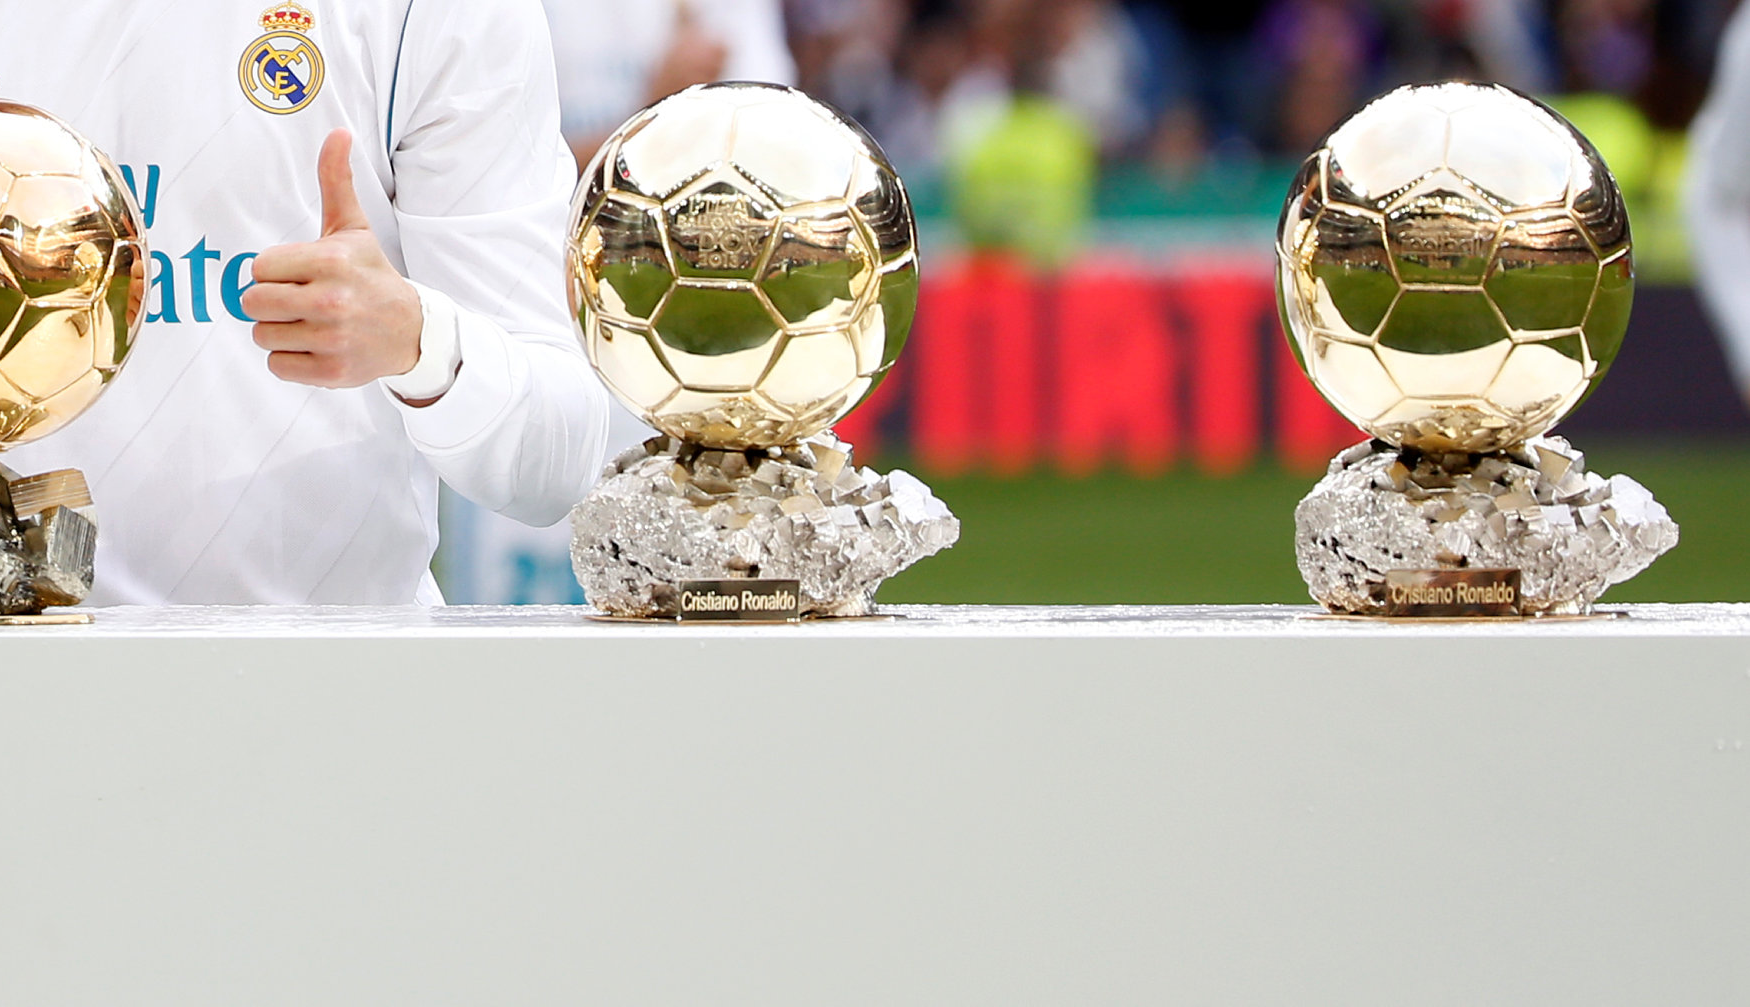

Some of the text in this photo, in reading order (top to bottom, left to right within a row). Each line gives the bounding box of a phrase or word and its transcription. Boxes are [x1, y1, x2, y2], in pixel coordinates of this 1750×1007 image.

[118, 164, 160, 229] y
[145, 235, 260, 323] ate
[681, 590, 796, 611] Cristiano Ronaldo
[1391, 581, 1514, 604] Cristiano Ronaldo
